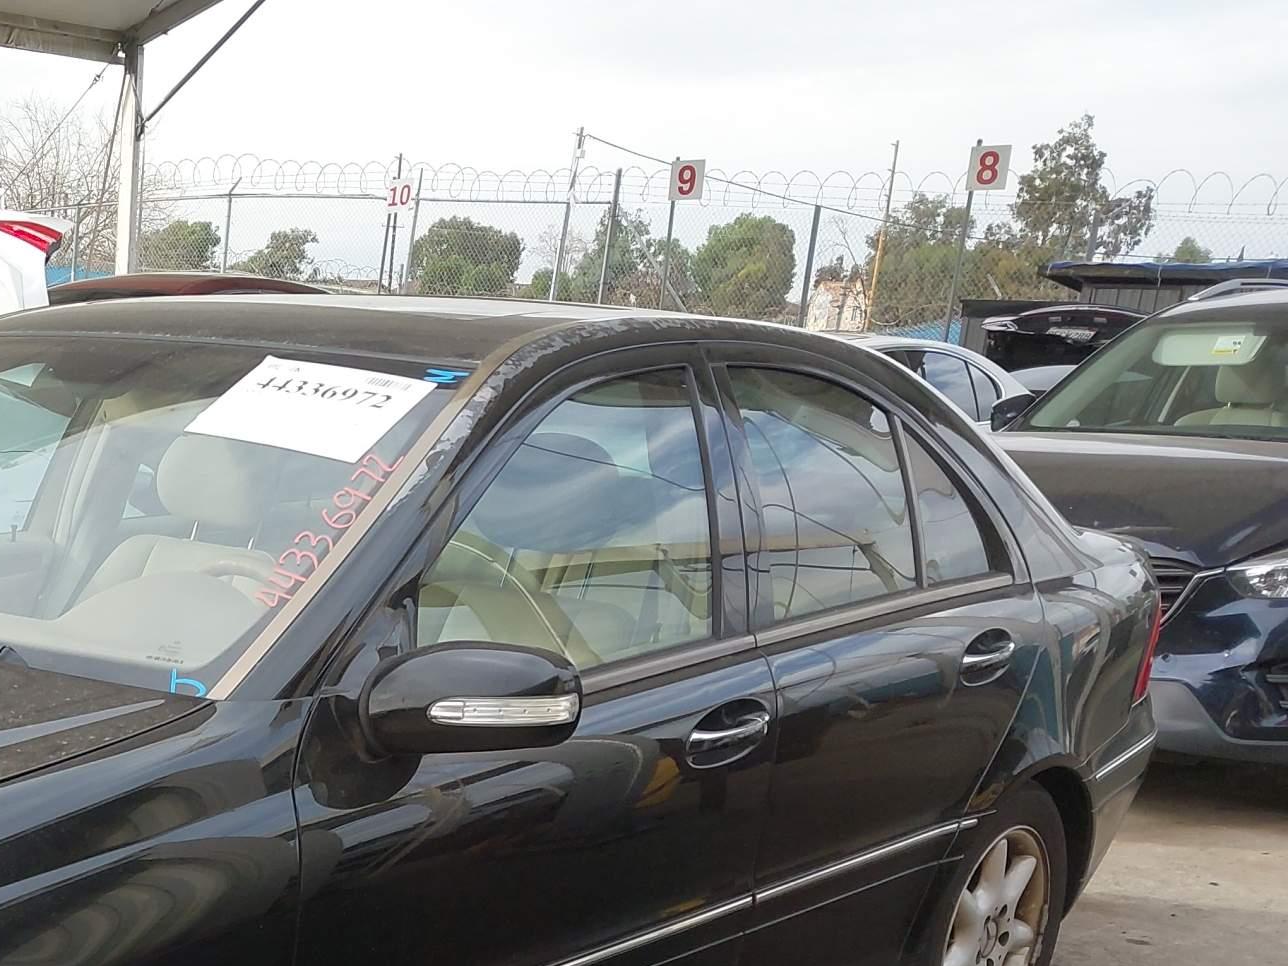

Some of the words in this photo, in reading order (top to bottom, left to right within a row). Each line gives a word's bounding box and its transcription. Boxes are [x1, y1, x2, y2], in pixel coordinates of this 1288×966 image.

[678, 165, 696, 195] 9
[977, 151, 999, 185] 8
[388, 185, 411, 206] 10
[257, 376, 393, 409] 44336972
[255, 454, 404, 608] 44336972
